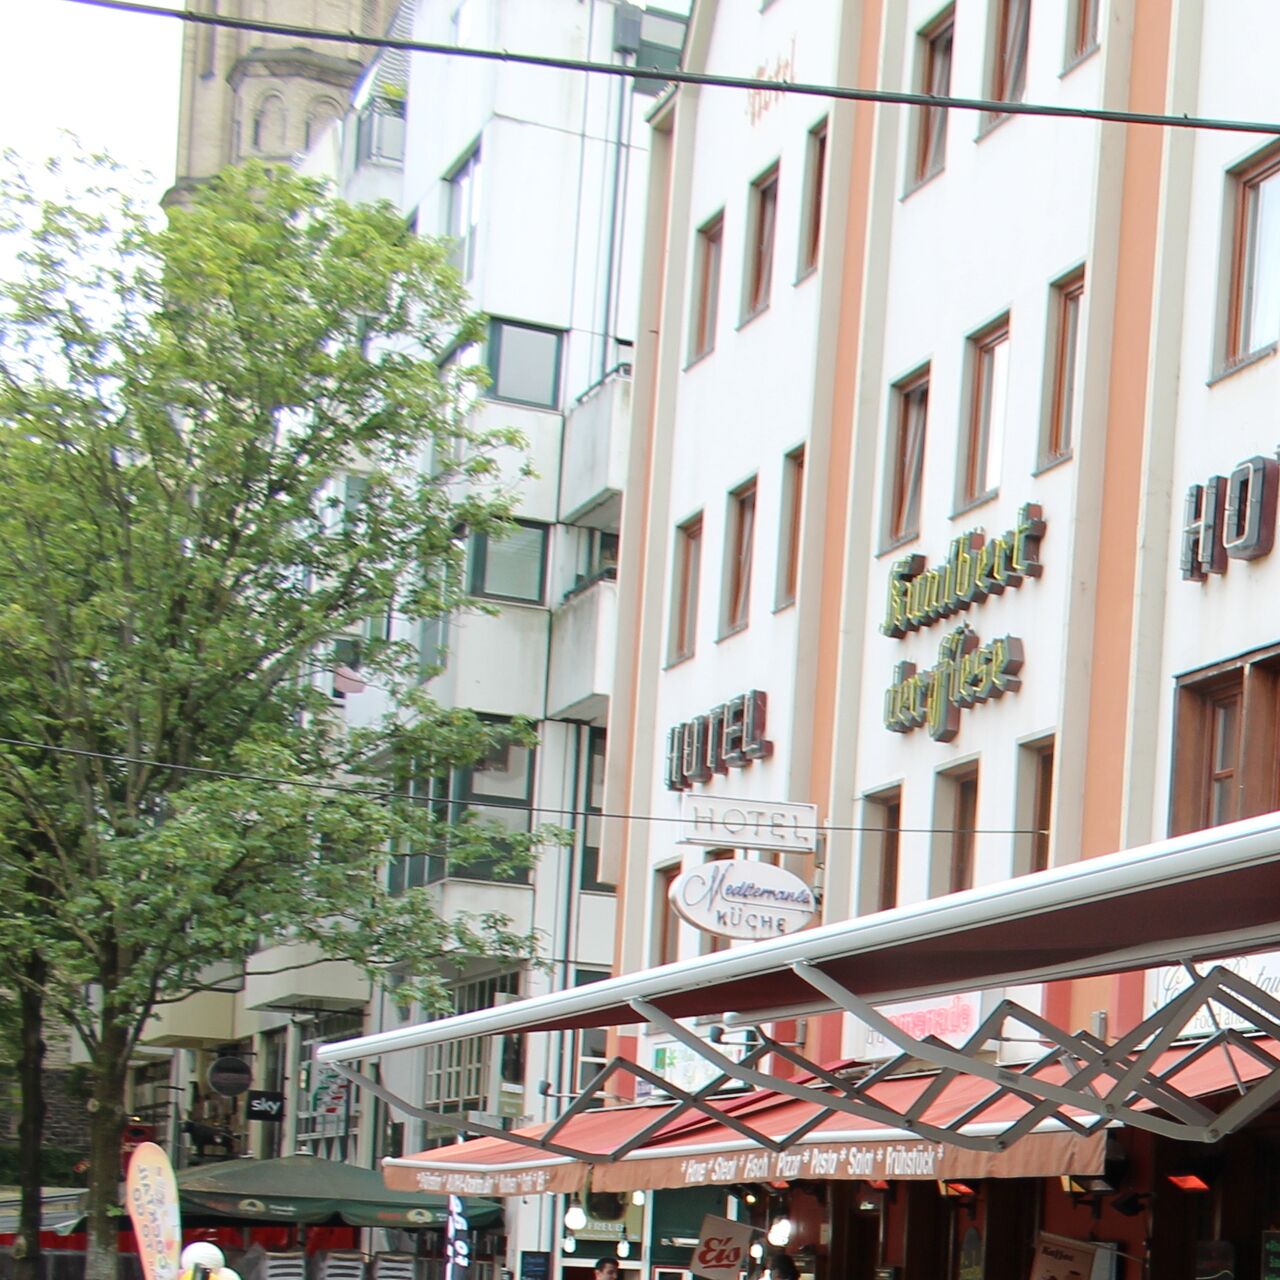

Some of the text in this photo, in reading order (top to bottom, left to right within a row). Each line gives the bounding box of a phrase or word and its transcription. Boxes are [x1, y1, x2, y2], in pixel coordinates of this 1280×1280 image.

[664, 689, 774, 792] HOTEL
[694, 806, 809, 842] HOTEL
[716, 906, 787, 932] KÜCHE
[251, 1097, 281, 1115] sky
[885, 1144, 935, 1175] Frühstück
[698, 1237, 741, 1264] Eis
